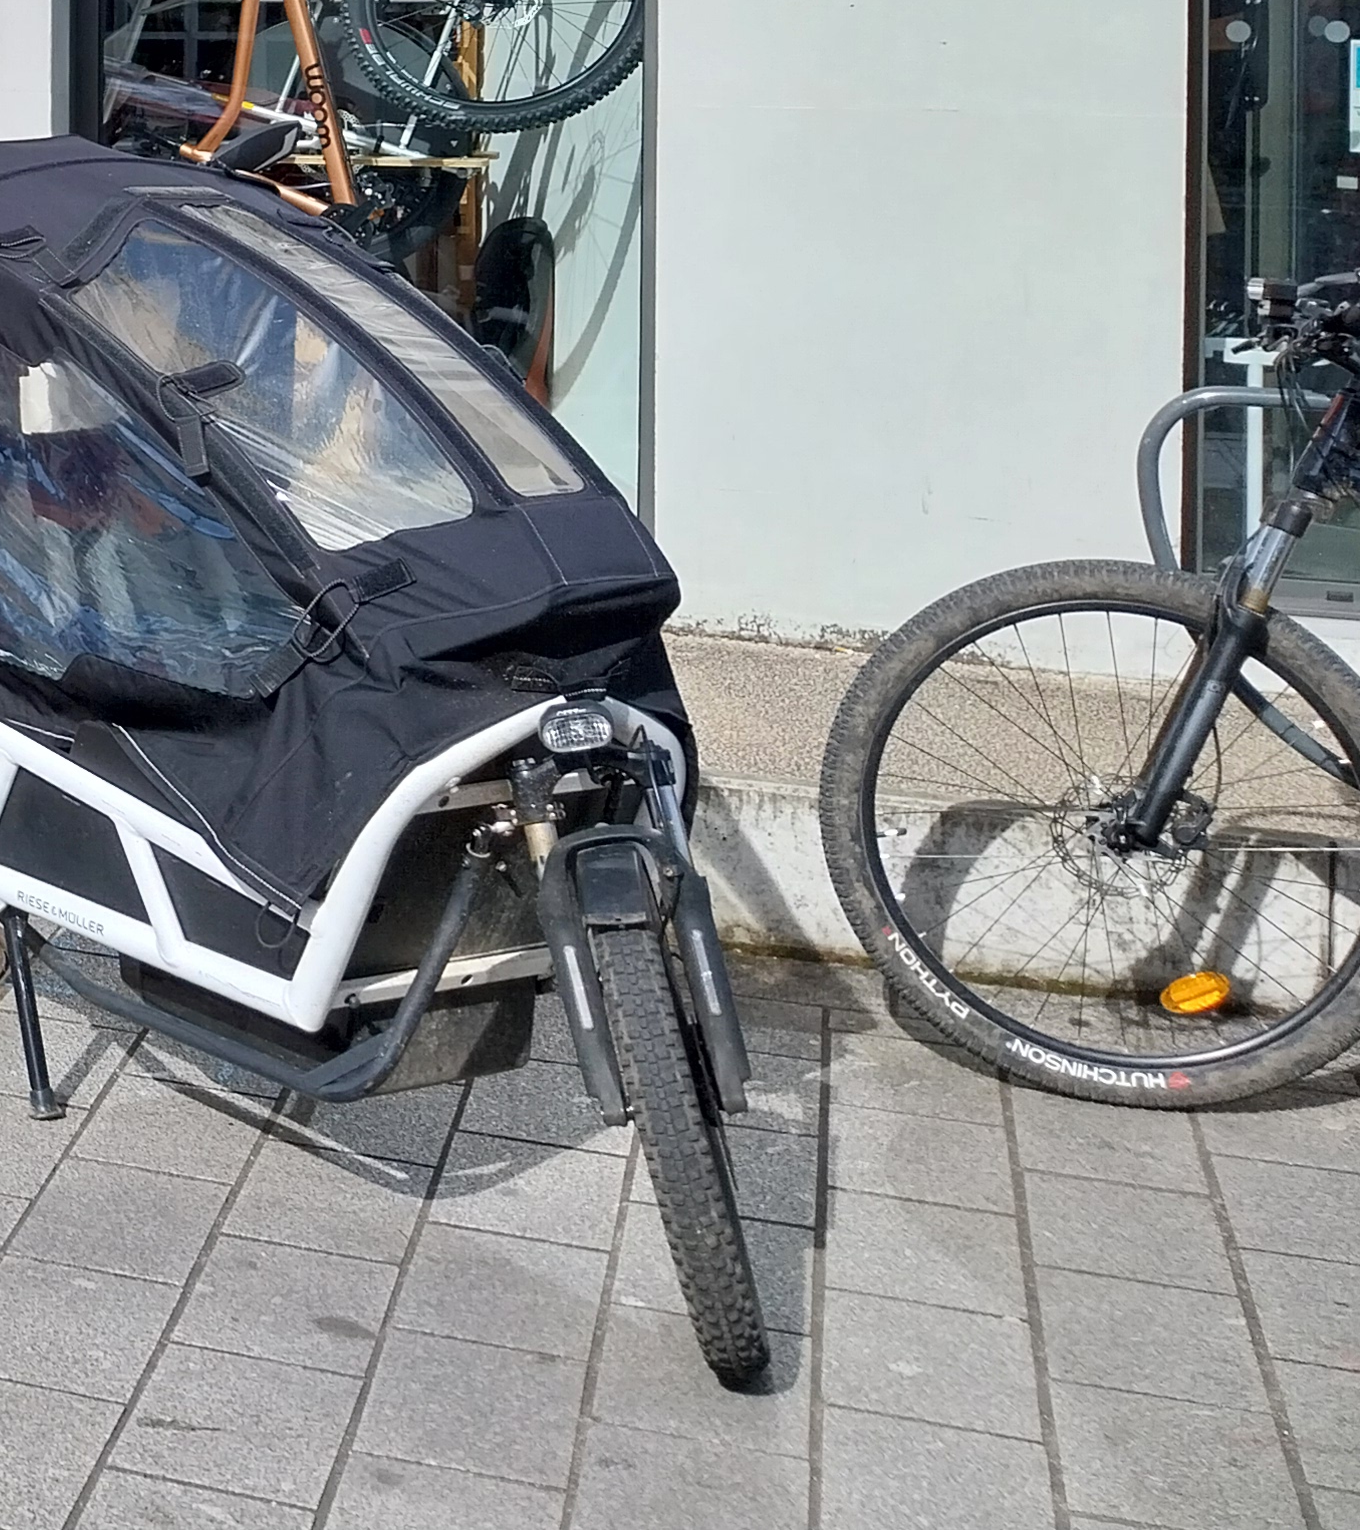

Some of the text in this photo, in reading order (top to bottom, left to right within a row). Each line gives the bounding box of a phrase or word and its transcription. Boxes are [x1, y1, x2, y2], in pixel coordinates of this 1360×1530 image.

[305, 62, 331, 149] woom
[887, 932, 970, 1019] PYTHON
[1011, 1038, 1168, 1090] HUTCHINSON
